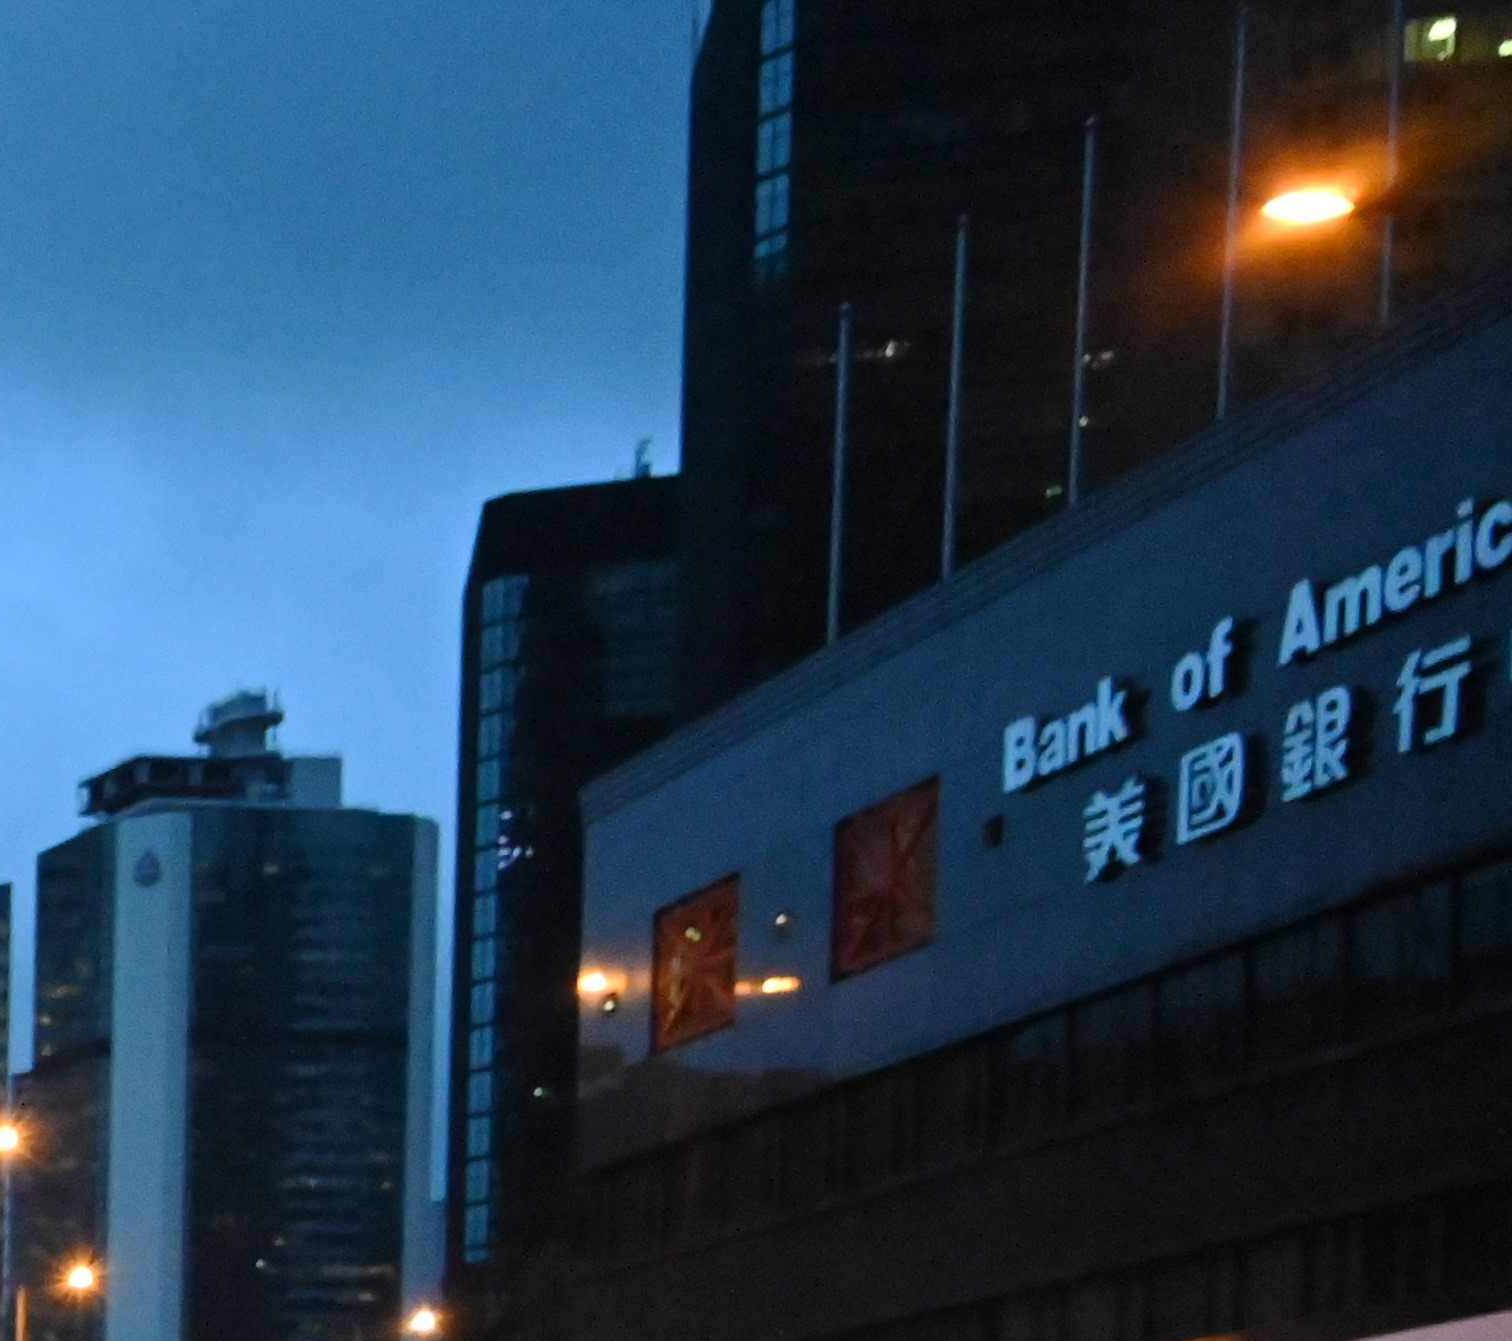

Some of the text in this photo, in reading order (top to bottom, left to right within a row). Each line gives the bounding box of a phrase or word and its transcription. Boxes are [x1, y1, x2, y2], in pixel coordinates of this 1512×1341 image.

[1003, 495, 1512, 794] Bank of Americ
[1083, 628, 1512, 884] 美國銀行
